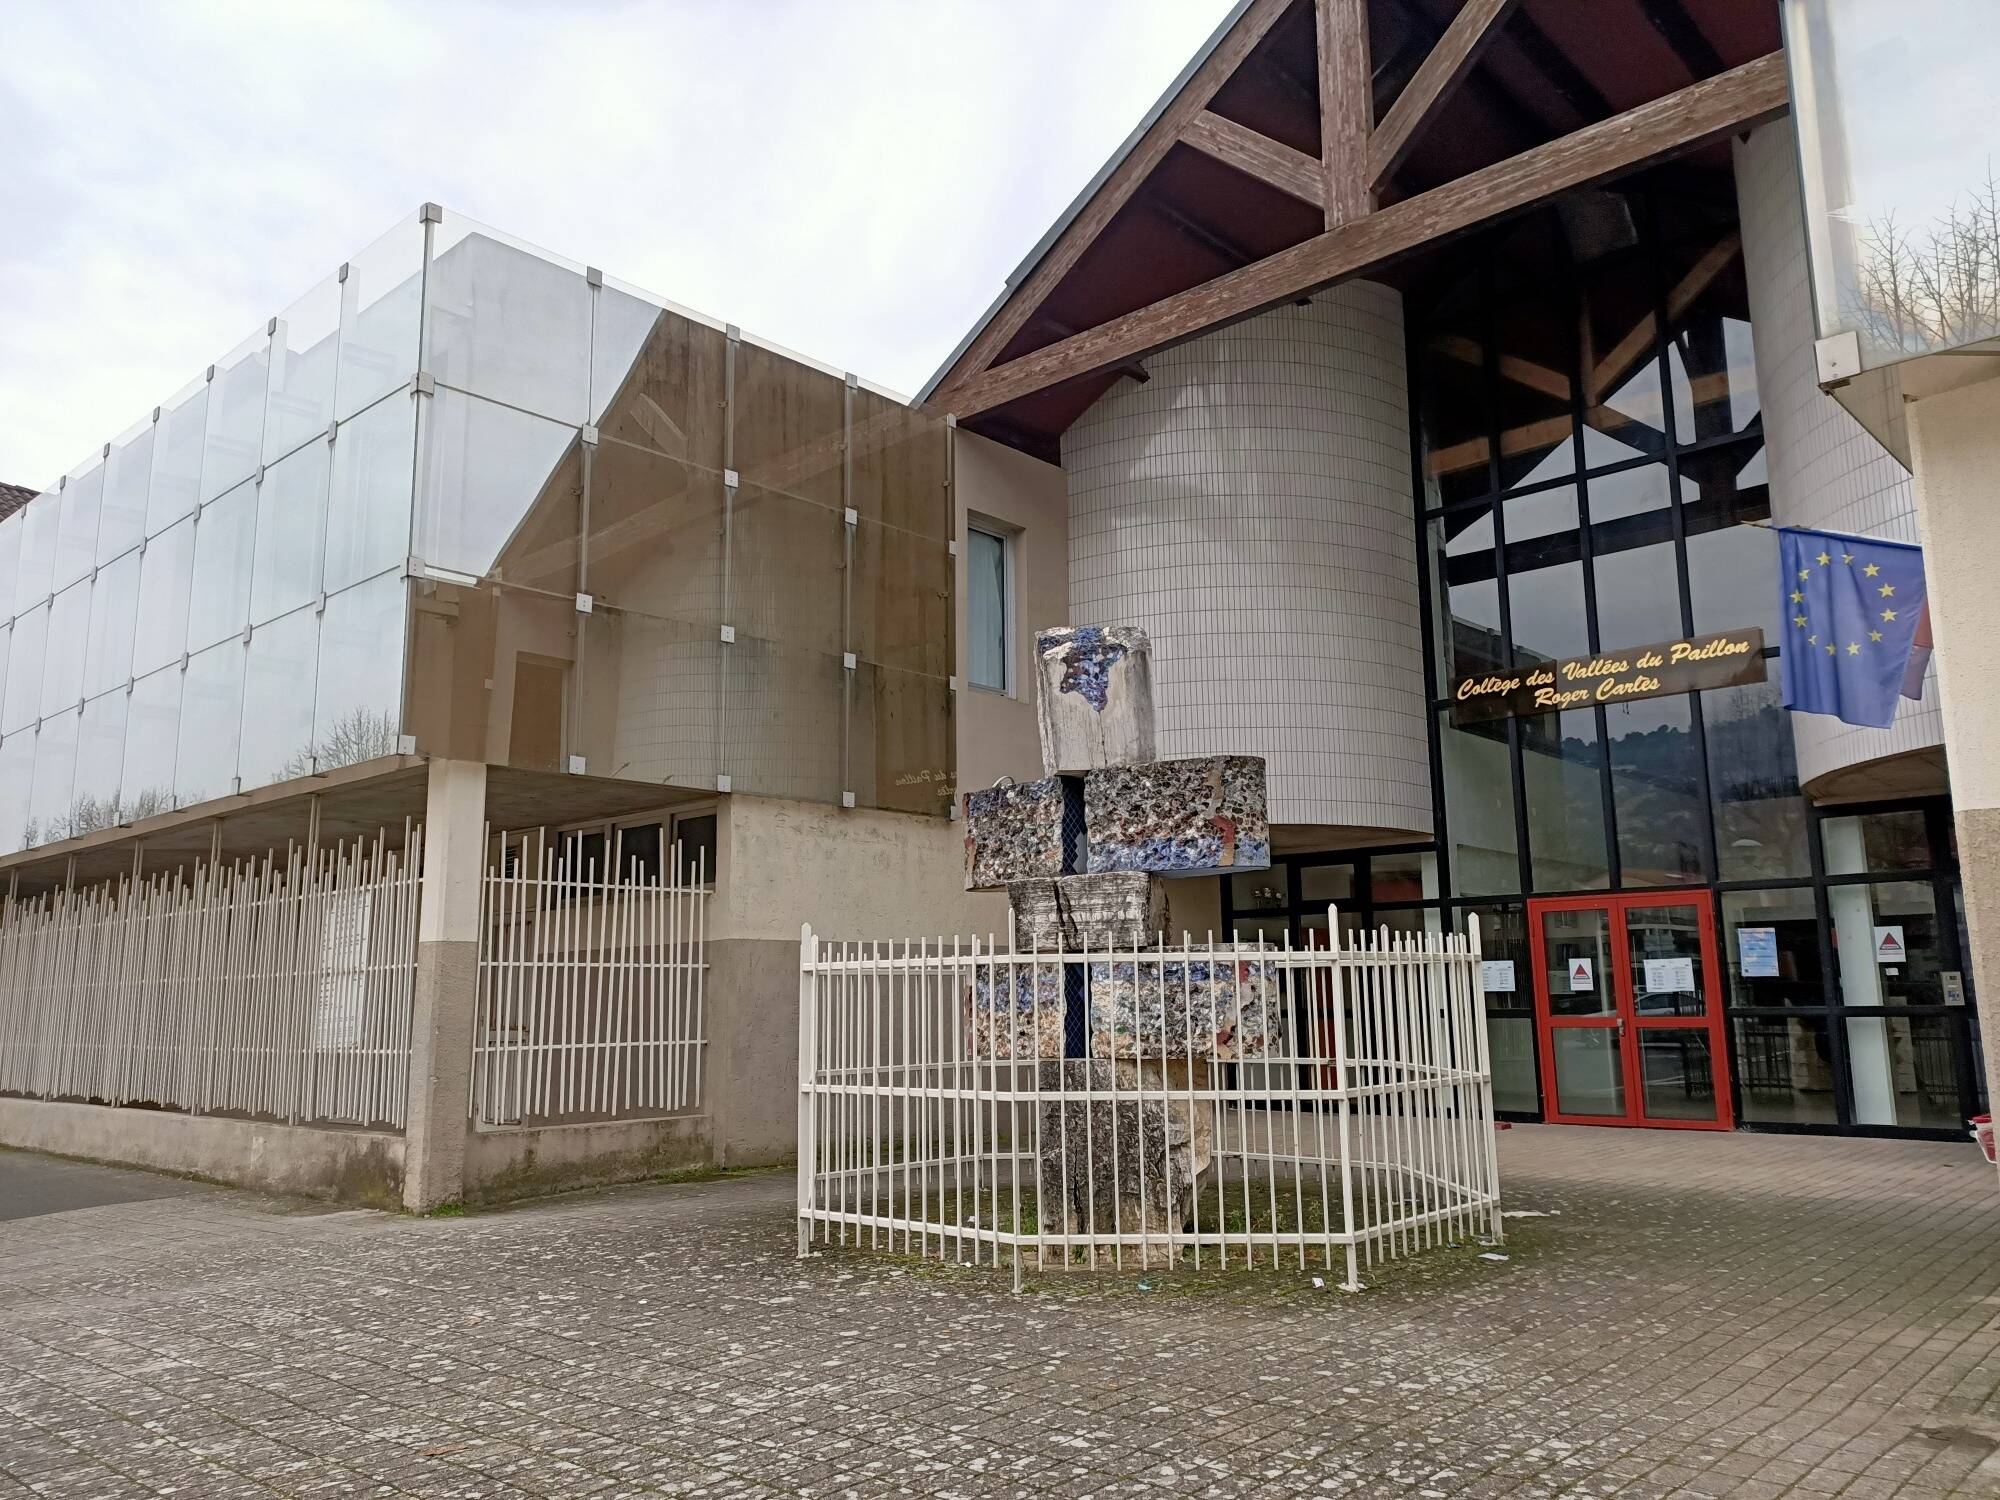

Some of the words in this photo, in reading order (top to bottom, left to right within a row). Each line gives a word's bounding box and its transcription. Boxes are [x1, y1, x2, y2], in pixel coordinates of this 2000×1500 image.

[1457, 676, 1521, 701] Collège
[1526, 669, 1556, 687] des
[1562, 658, 1630, 681] Vallées
[1636, 651, 1664, 669] du
[1670, 638, 1750, 665] Paillon
[1534, 687, 1590, 709] Roger
